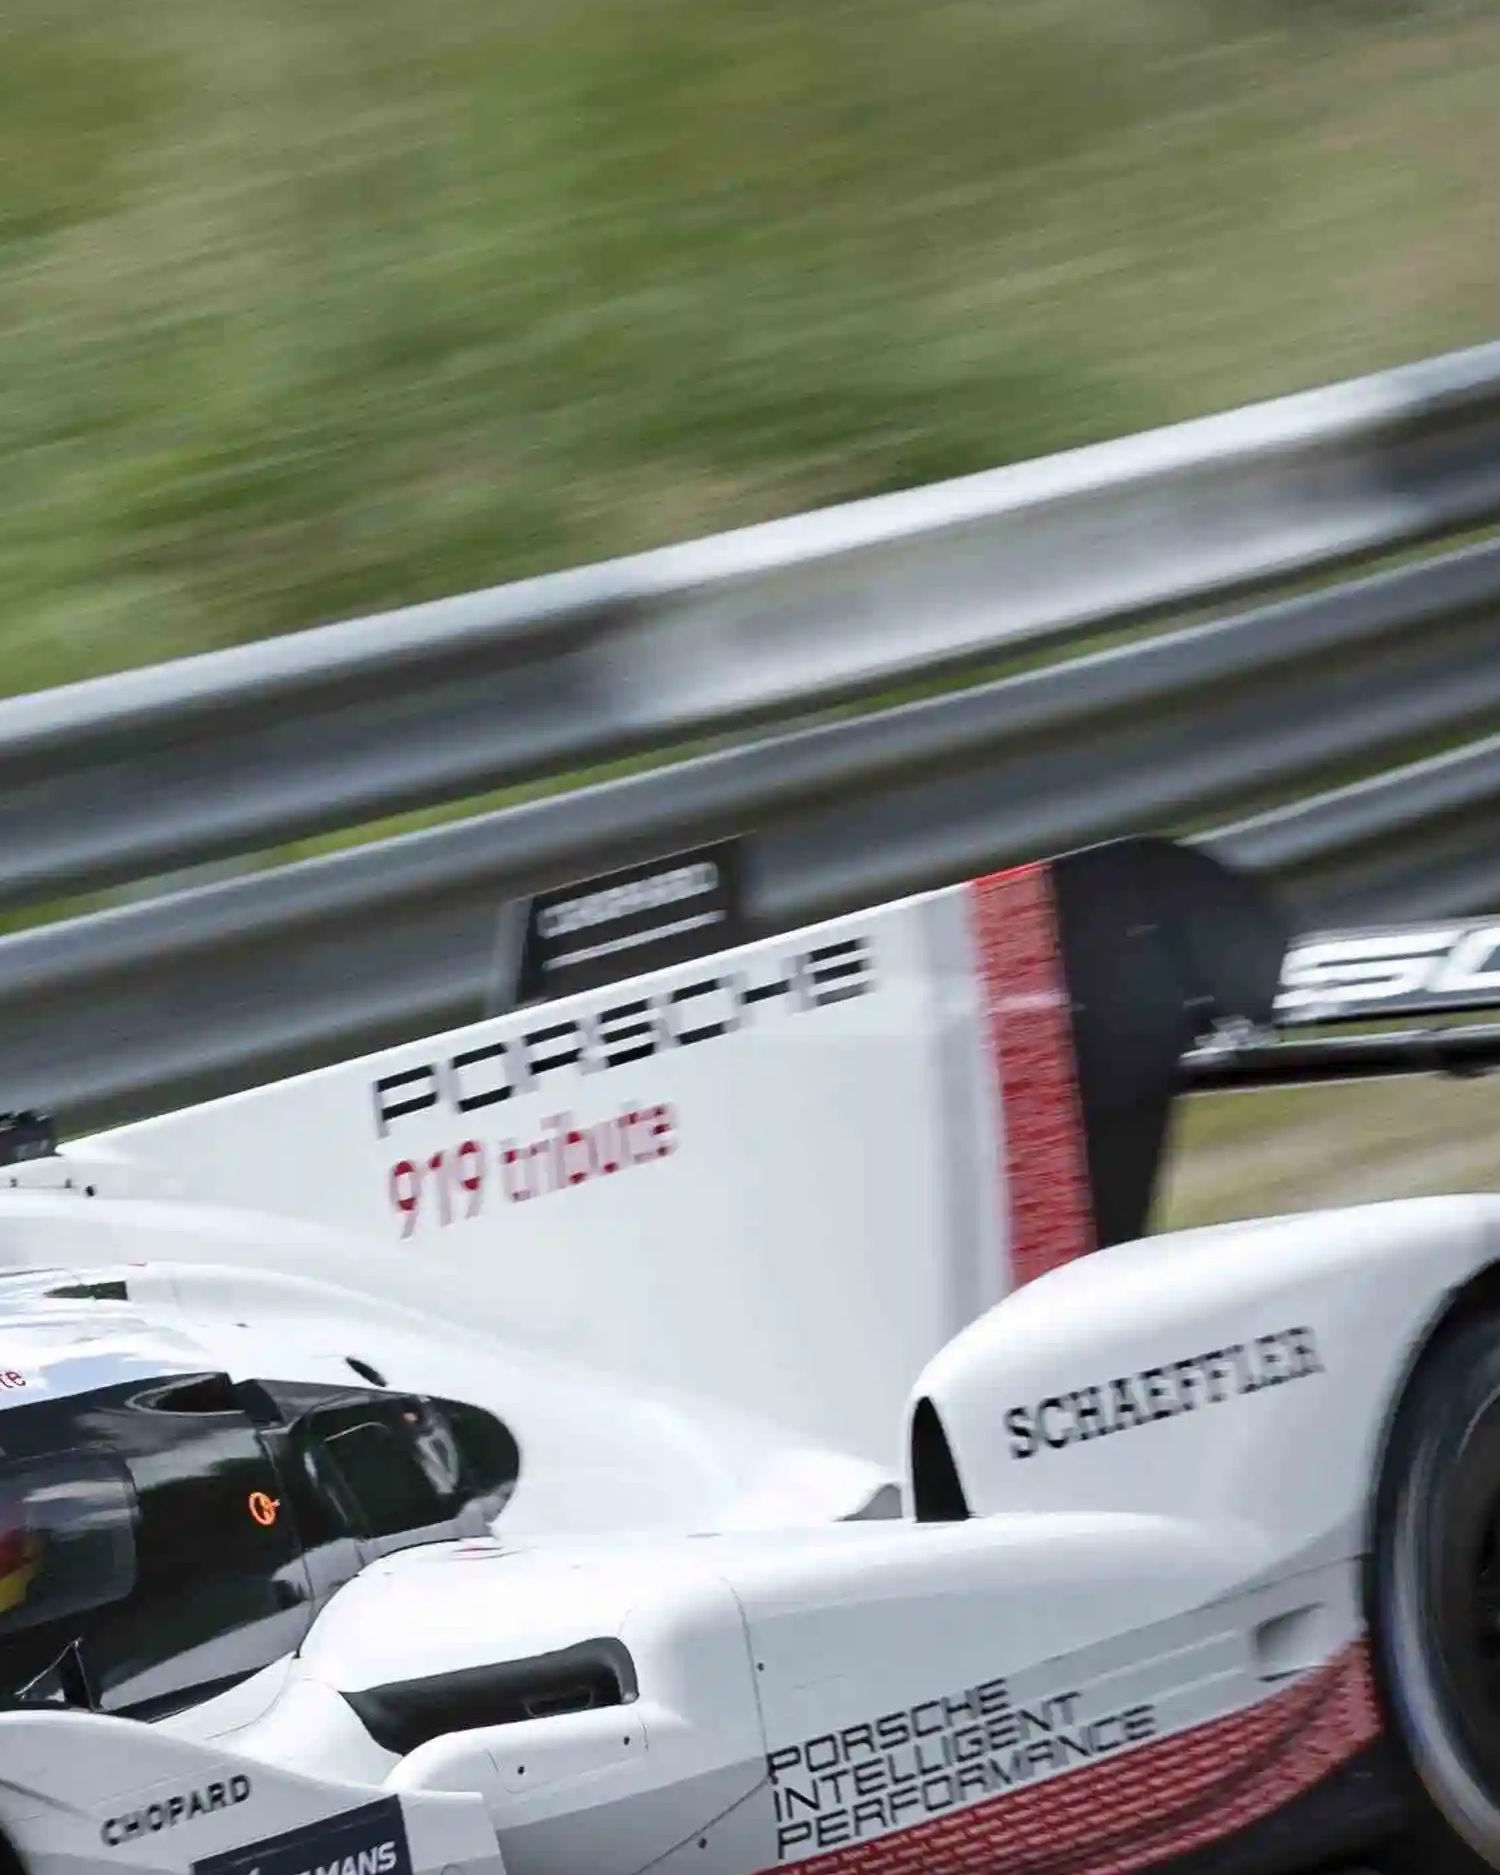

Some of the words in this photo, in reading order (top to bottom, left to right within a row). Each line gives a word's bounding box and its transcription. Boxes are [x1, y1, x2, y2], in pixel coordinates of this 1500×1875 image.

[374, 937, 876, 1137] PORSCHE
[388, 1140, 487, 1239] 919
[502, 1100, 678, 1204] tribute
[1005, 1325, 1324, 1459] SCHAEFFLER
[767, 1678, 1009, 1784] PORSCHE
[772, 1692, 1084, 1822] INTELLIGENT
[778, 1704, 1157, 1859] PERFORMANCE
[101, 1774, 252, 1848] CHOPARD
